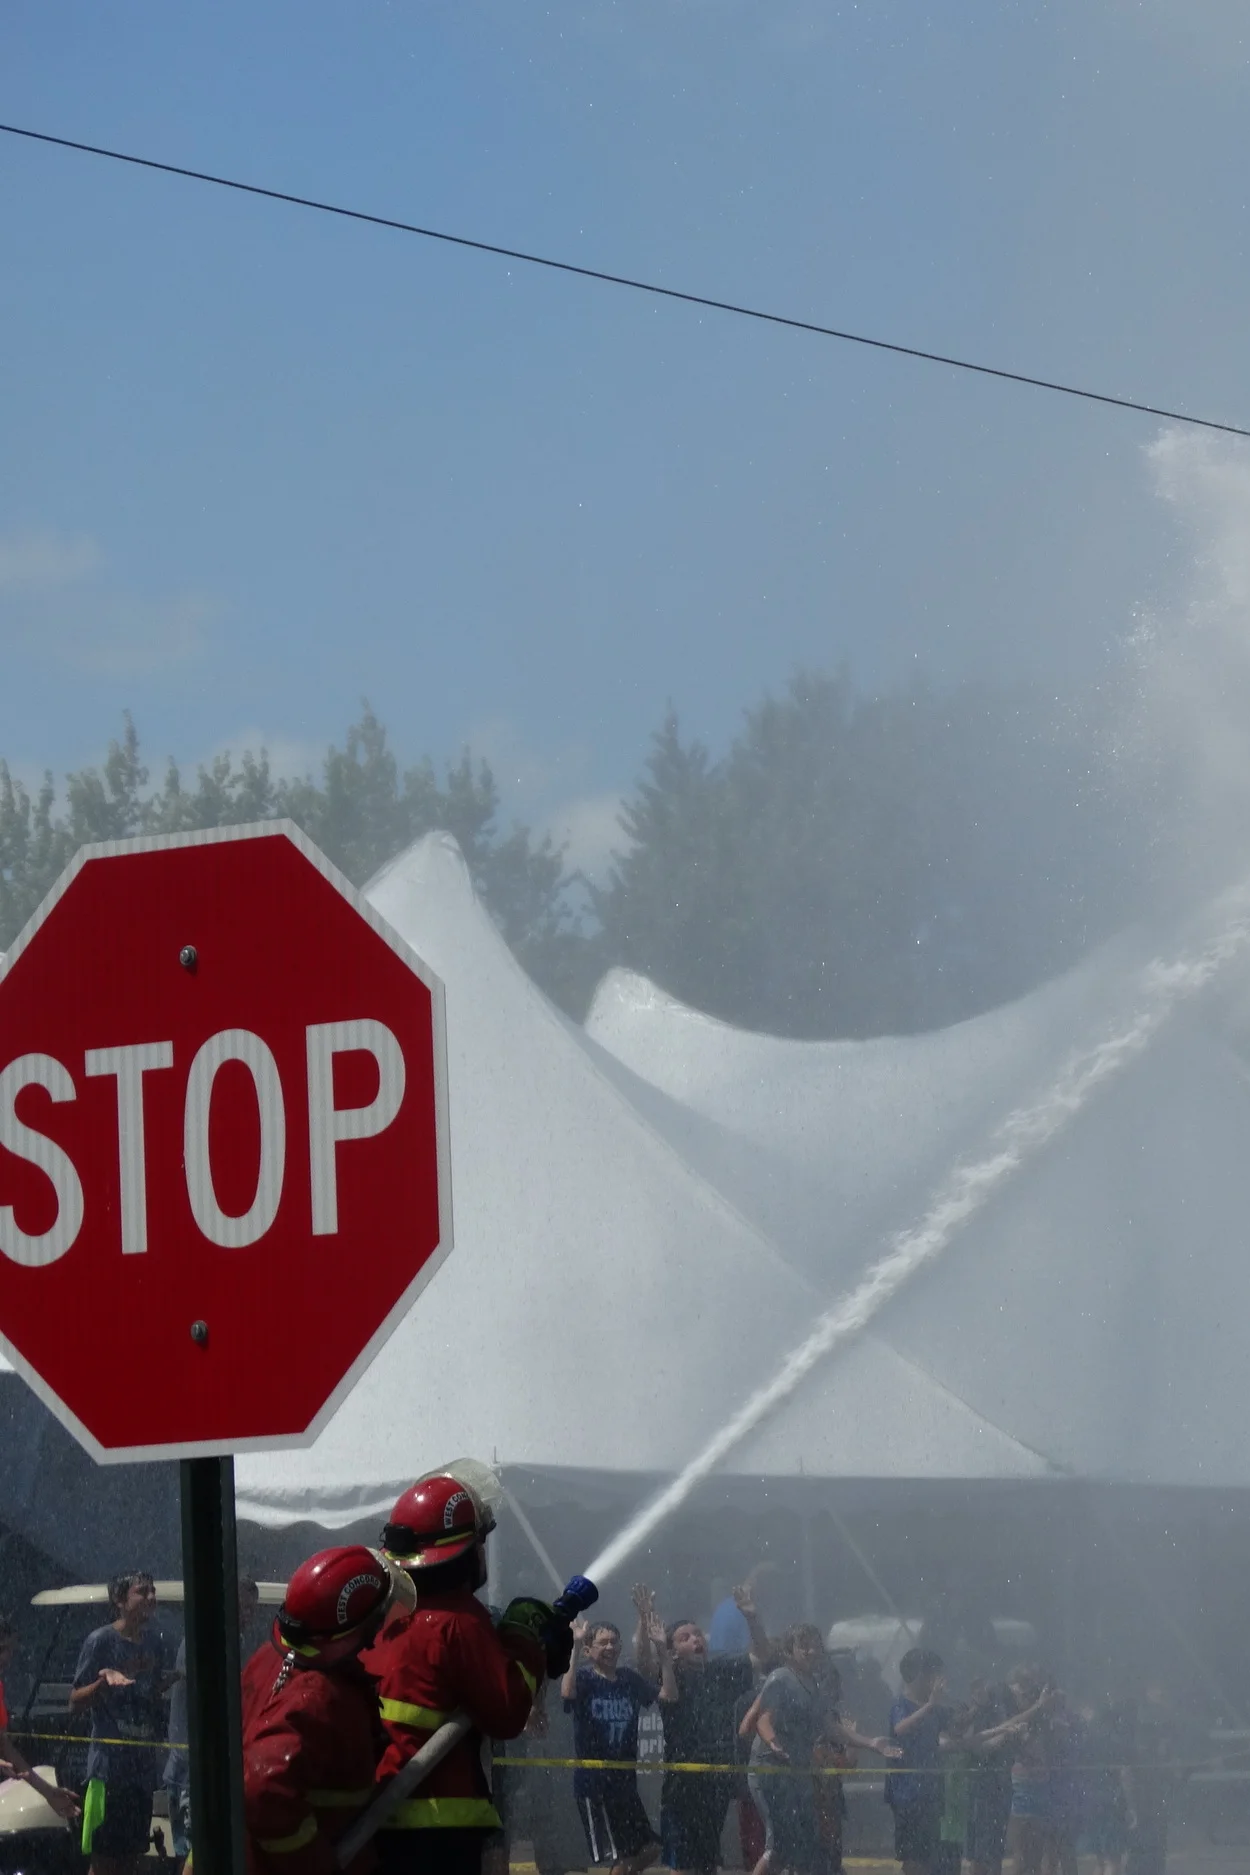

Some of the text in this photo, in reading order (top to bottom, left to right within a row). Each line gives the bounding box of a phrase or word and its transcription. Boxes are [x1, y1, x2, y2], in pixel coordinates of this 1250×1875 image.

[0, 1018, 406, 1268] STOP
[444, 1500, 455, 1526] WEST
[337, 1574, 380, 1621] WEST CONCORD
